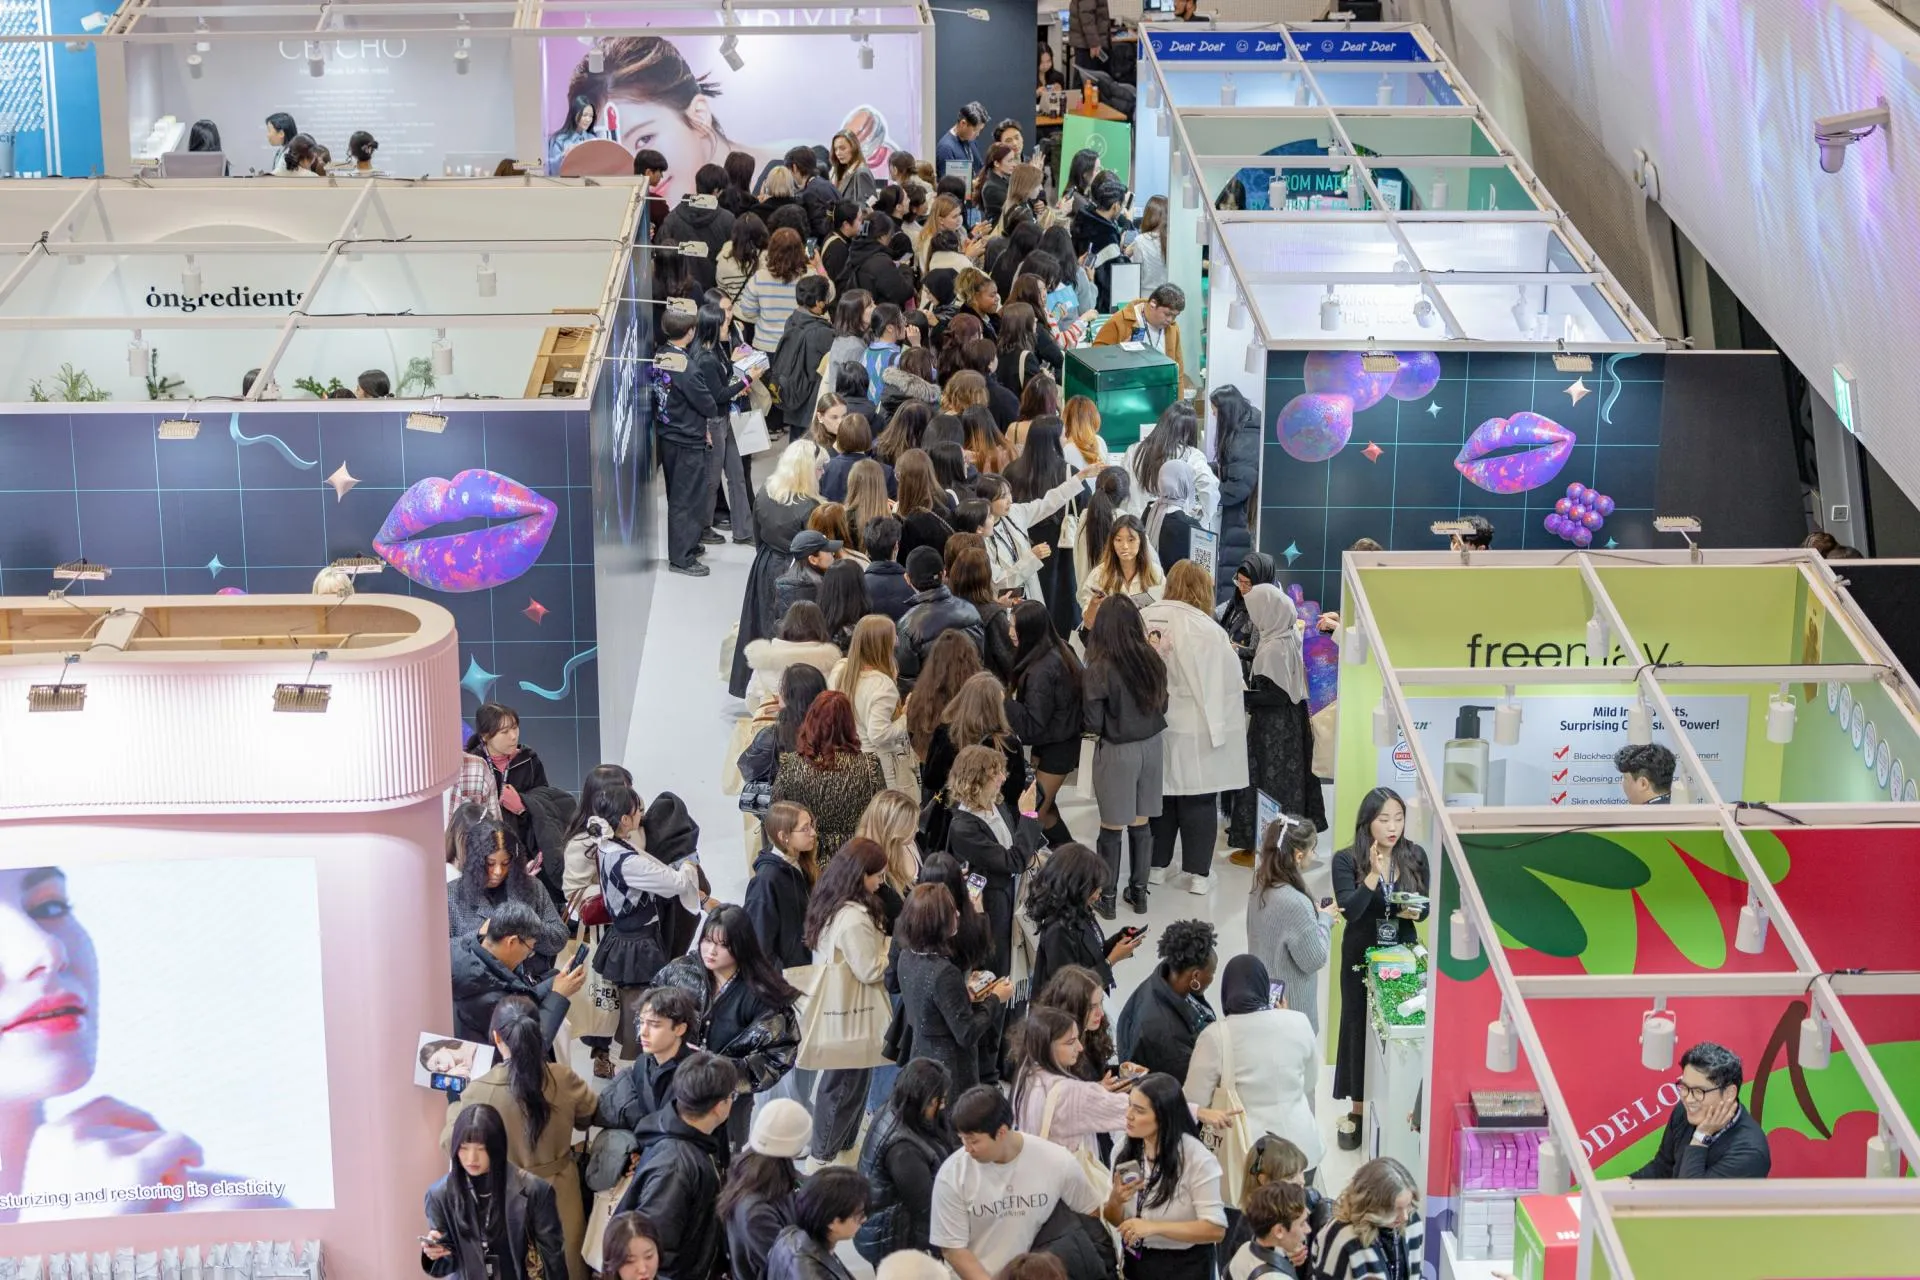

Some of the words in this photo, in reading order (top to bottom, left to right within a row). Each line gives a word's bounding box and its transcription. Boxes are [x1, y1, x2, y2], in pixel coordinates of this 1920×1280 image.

[1169, 41, 1196, 52] Dear
[1198, 41, 1227, 52] Doer
[1255, 41, 1283, 52] Dear
[1340, 41, 1368, 52] Dear
[1369, 41, 1397, 52] Doer
[1285, 174, 1311, 191] ROM
[1467, 633, 1670, 668] freemy
[1593, 707, 1617, 717] Mild
[1560, 720, 1618, 732] Surprising
[1679, 719, 1720, 731] Power!
[1572, 775, 1613, 784] Cleansing
[1571, 797, 1588, 805] Skin
[1580, 1075, 1684, 1160] DELO
[74, 1187, 107, 1202] and
[110, 1183, 184, 1200] restoring
[188, 1180, 208, 1196] its
[212, 1179, 286, 1197] elasticity
[972, 1192, 1048, 1218] UNDEFINED
